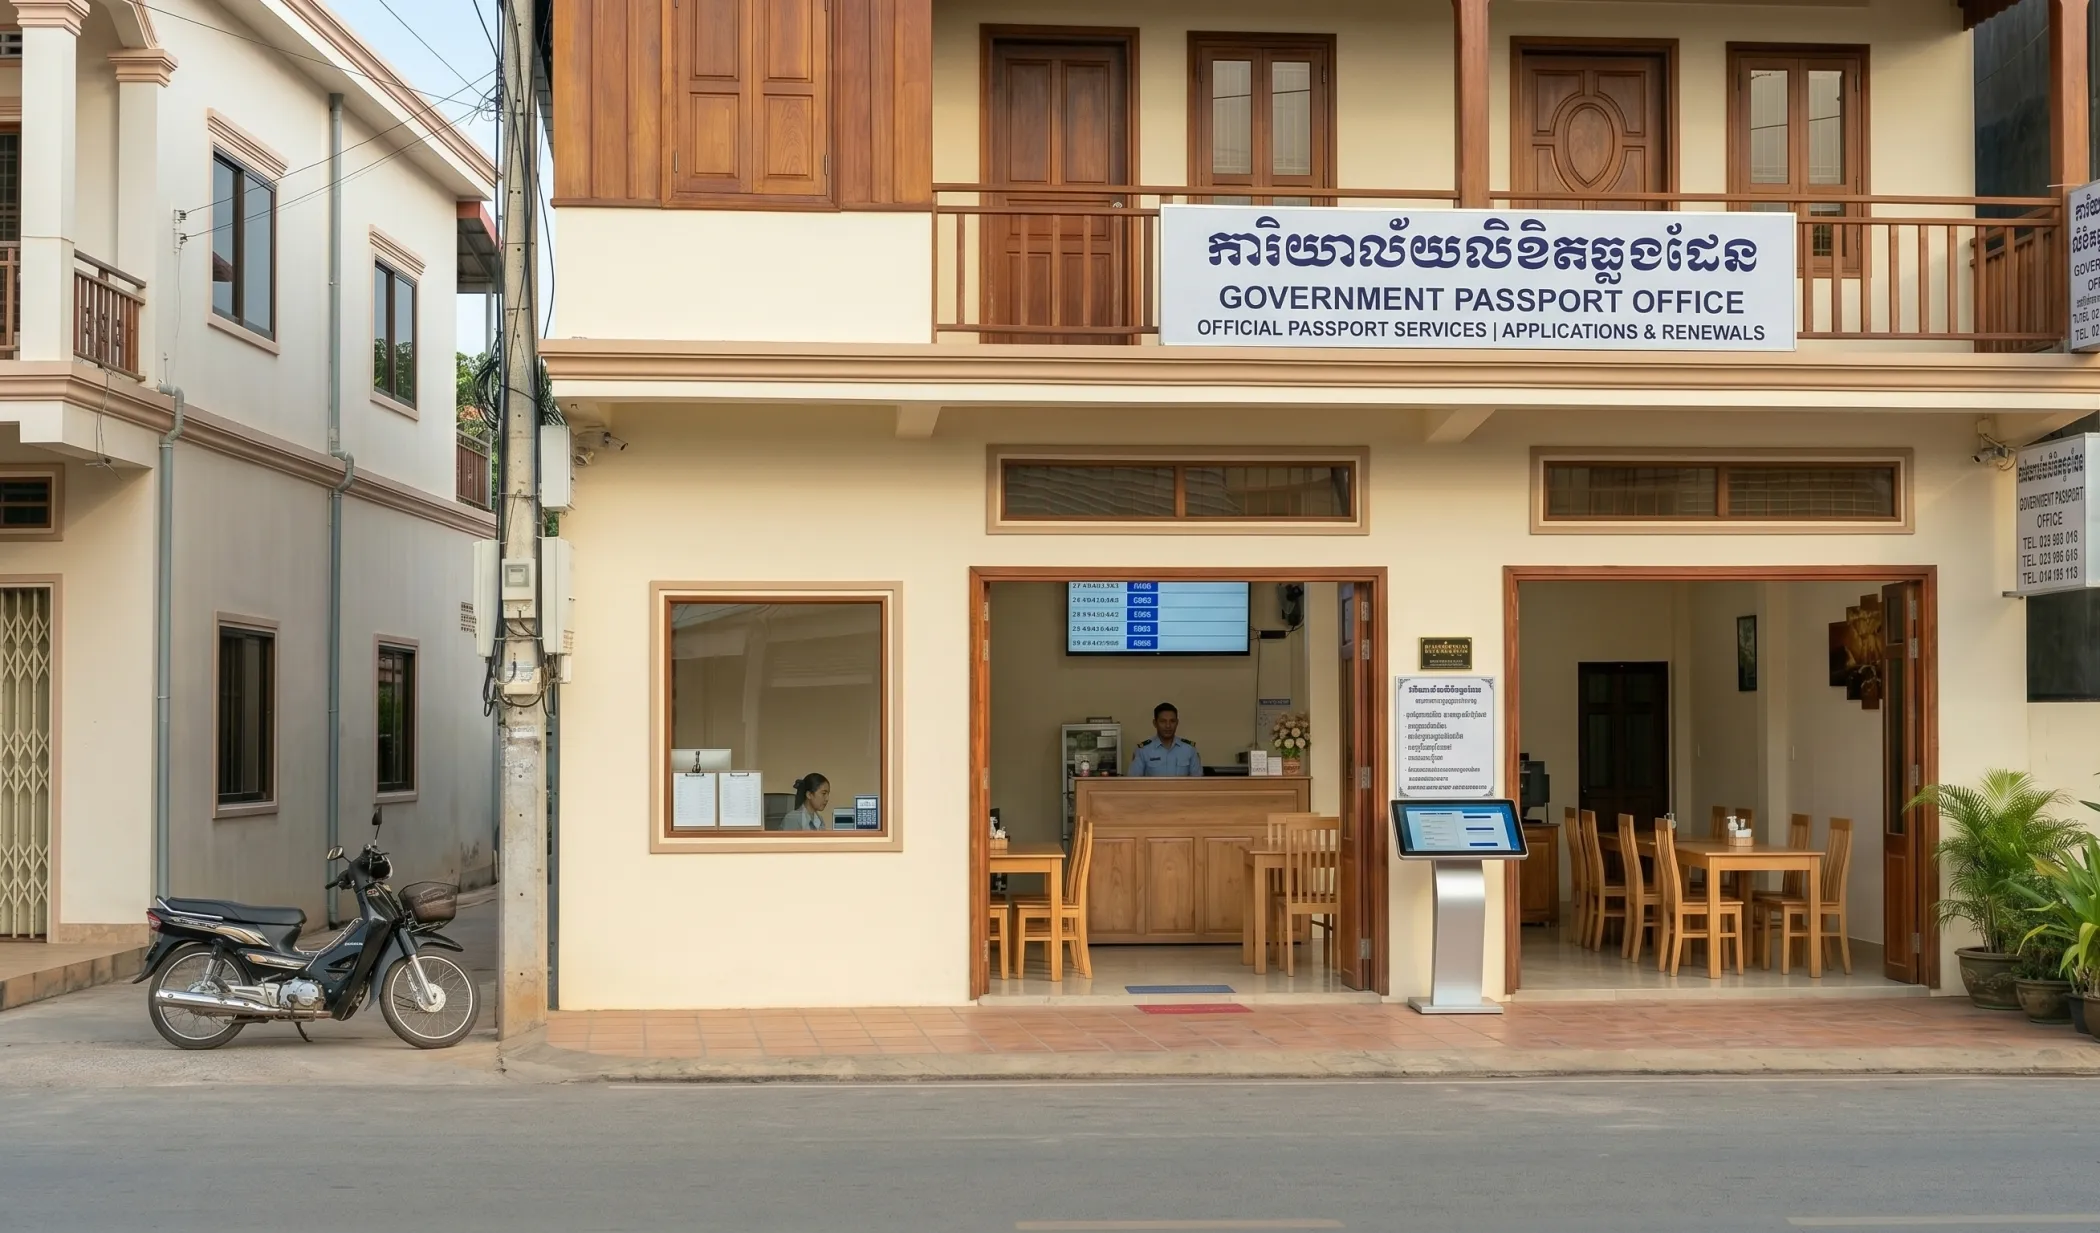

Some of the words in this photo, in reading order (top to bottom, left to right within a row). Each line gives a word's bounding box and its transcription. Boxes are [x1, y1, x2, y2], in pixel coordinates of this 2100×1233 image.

[1219, 285, 1445, 311] GOVERNMENT
[1455, 287, 1623, 313] PASSPORT
[1632, 289, 1744, 315] OFFICE
[1197, 319, 1283, 336] OFFICIAL
[1288, 320, 1389, 337] PASSPORT
[1394, 321, 1488, 338] SERVICES
[1501, 322, 1638, 340] APPLICATIONS
[1643, 324, 1657, 340] &
[1662, 324, 1766, 341] RENEWALS
[2036, 511, 2063, 529] OFFICE
